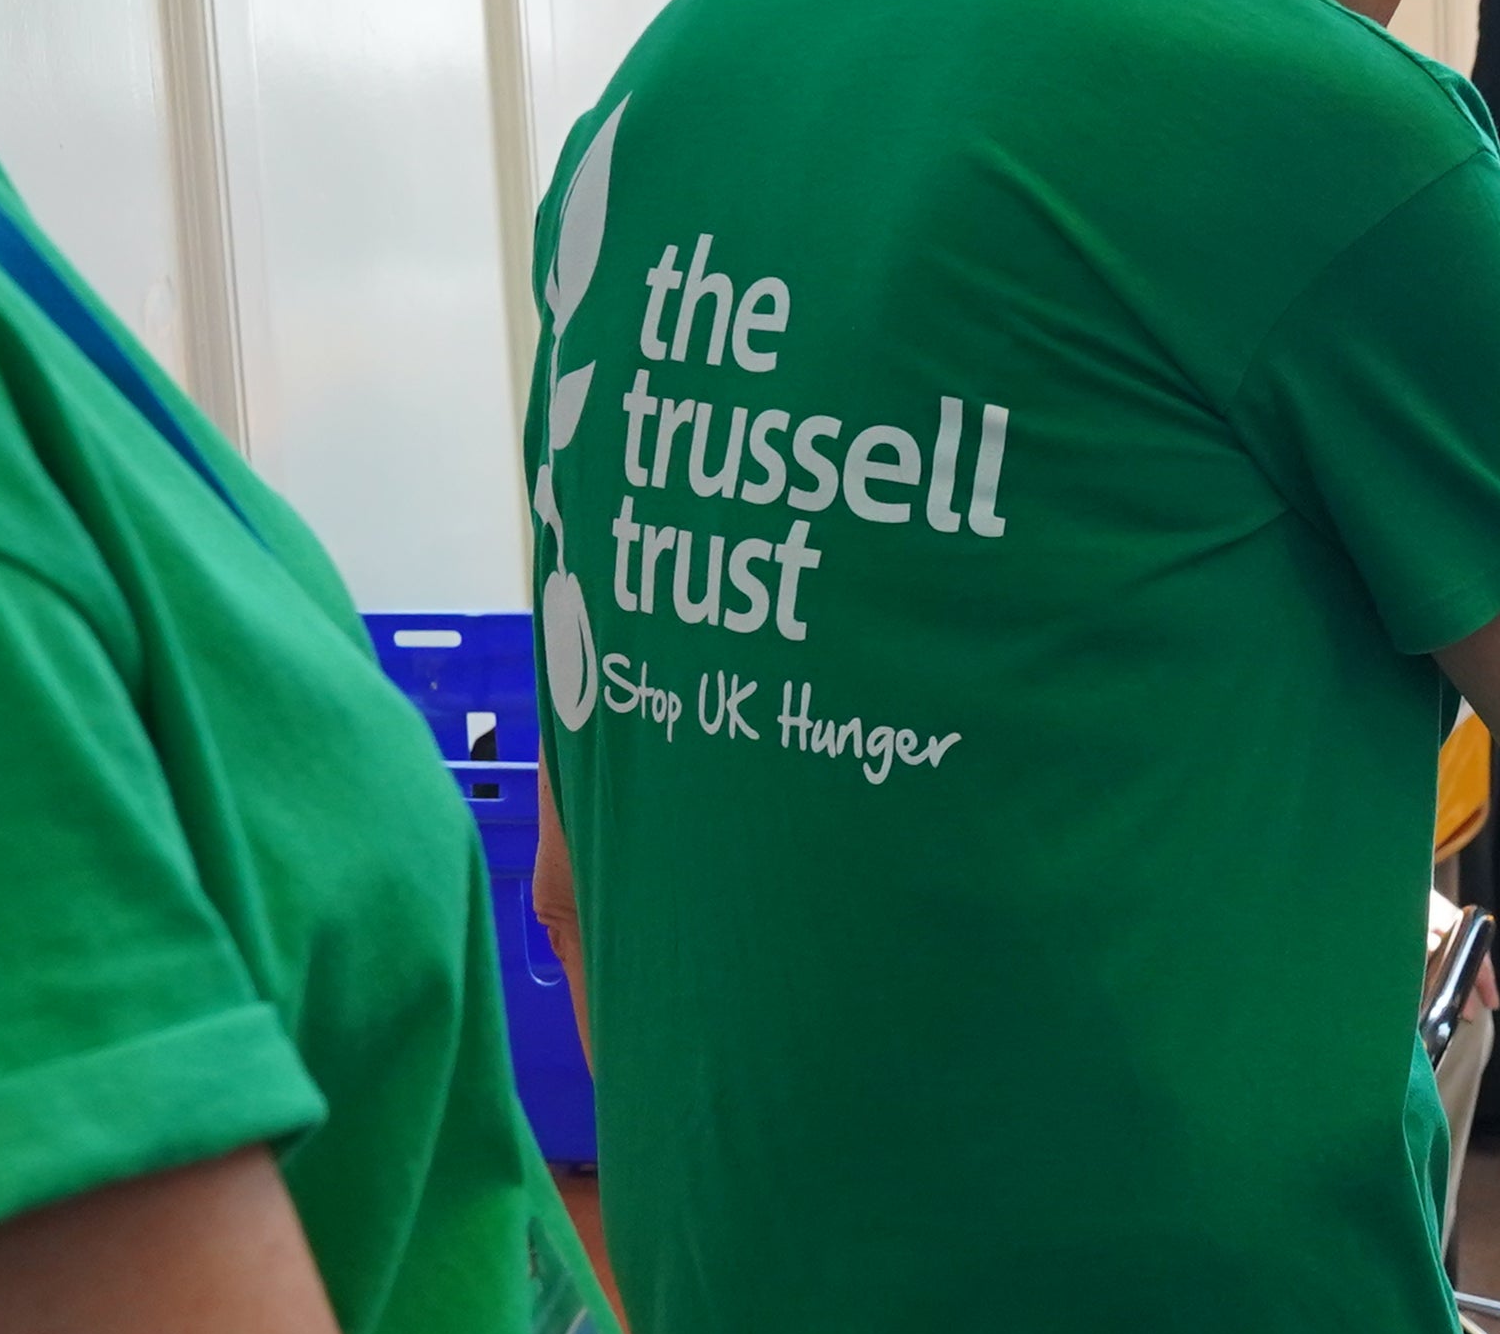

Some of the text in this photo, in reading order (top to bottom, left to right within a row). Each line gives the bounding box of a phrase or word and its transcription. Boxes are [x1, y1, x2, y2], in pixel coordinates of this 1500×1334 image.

[639, 232, 791, 373] the
[621, 368, 1010, 538] trussell
[611, 495, 822, 641] trust
[601, 652, 963, 786] Stop UK Hunger
